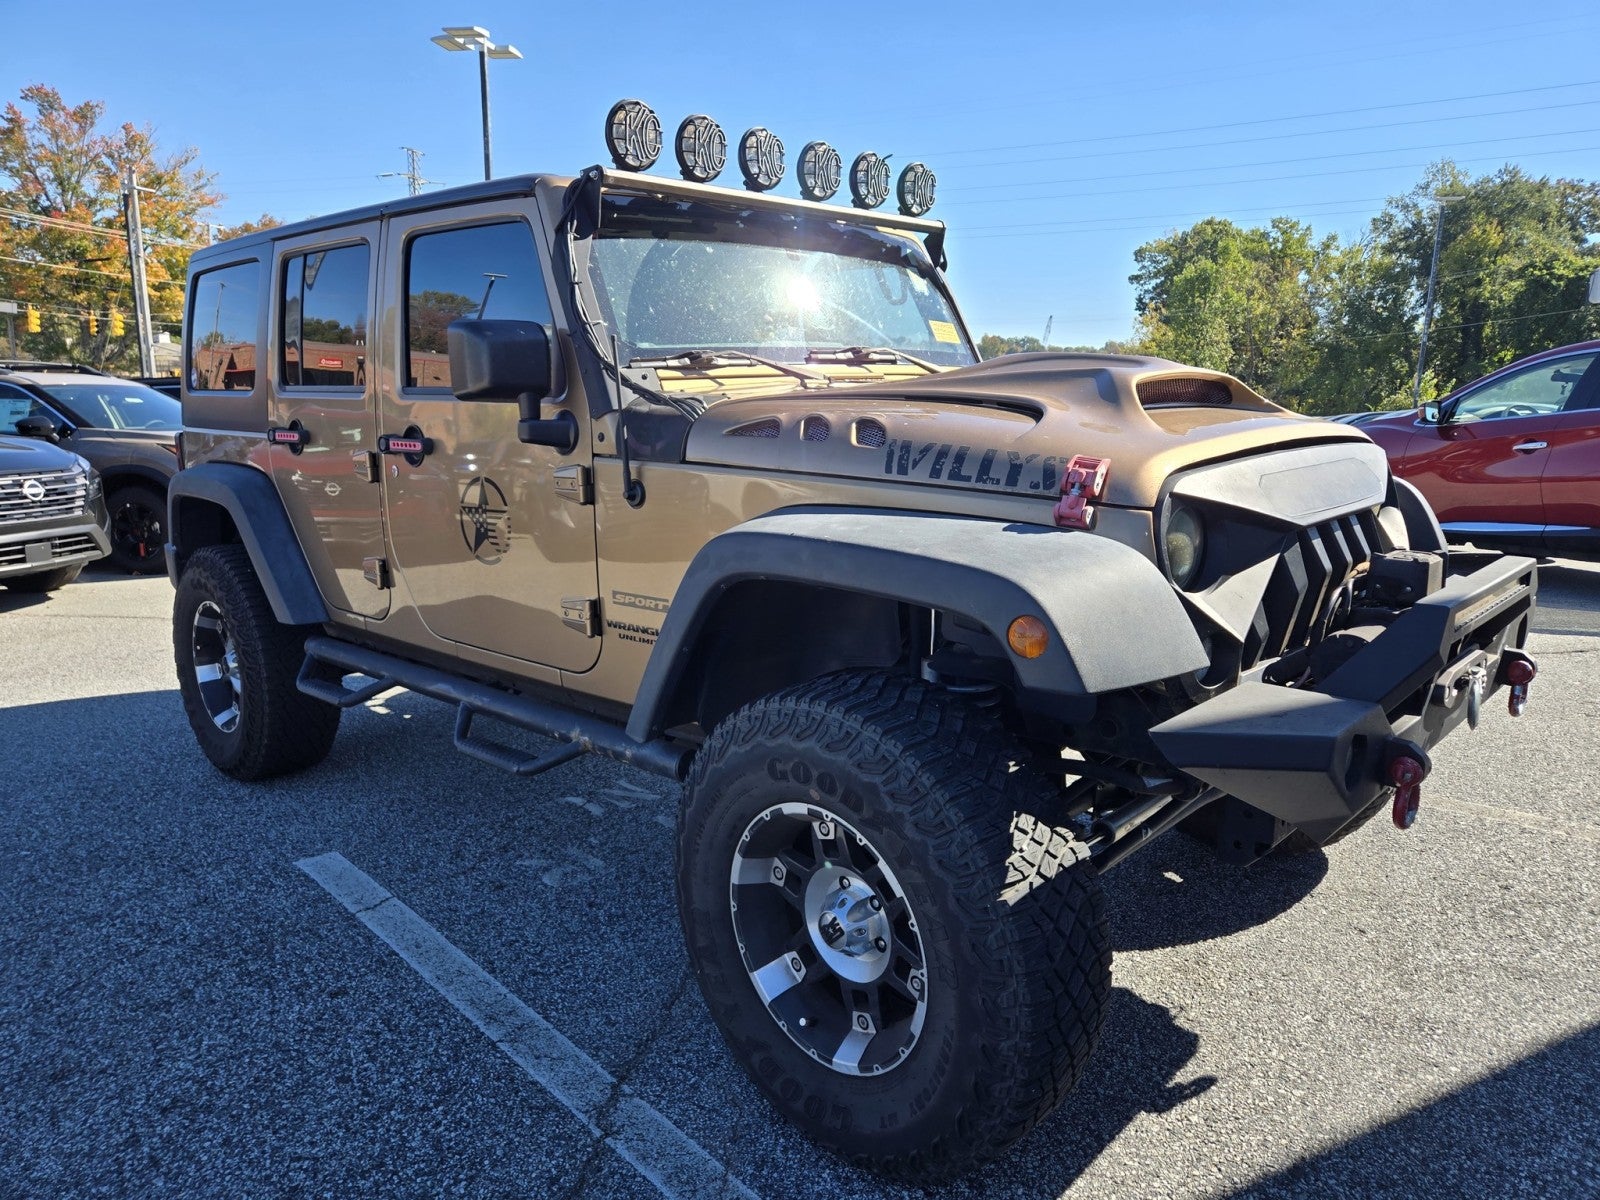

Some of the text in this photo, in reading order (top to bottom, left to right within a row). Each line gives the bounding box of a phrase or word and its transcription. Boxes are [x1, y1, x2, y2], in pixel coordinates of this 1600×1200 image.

[627, 107, 662, 162] KC
[697, 119, 727, 172] KC
[757, 132, 784, 180] KC
[814, 144, 840, 191] KC
[870, 157, 891, 200] KC
[914, 168, 935, 210] KC
[614, 594, 668, 610] SPORT
